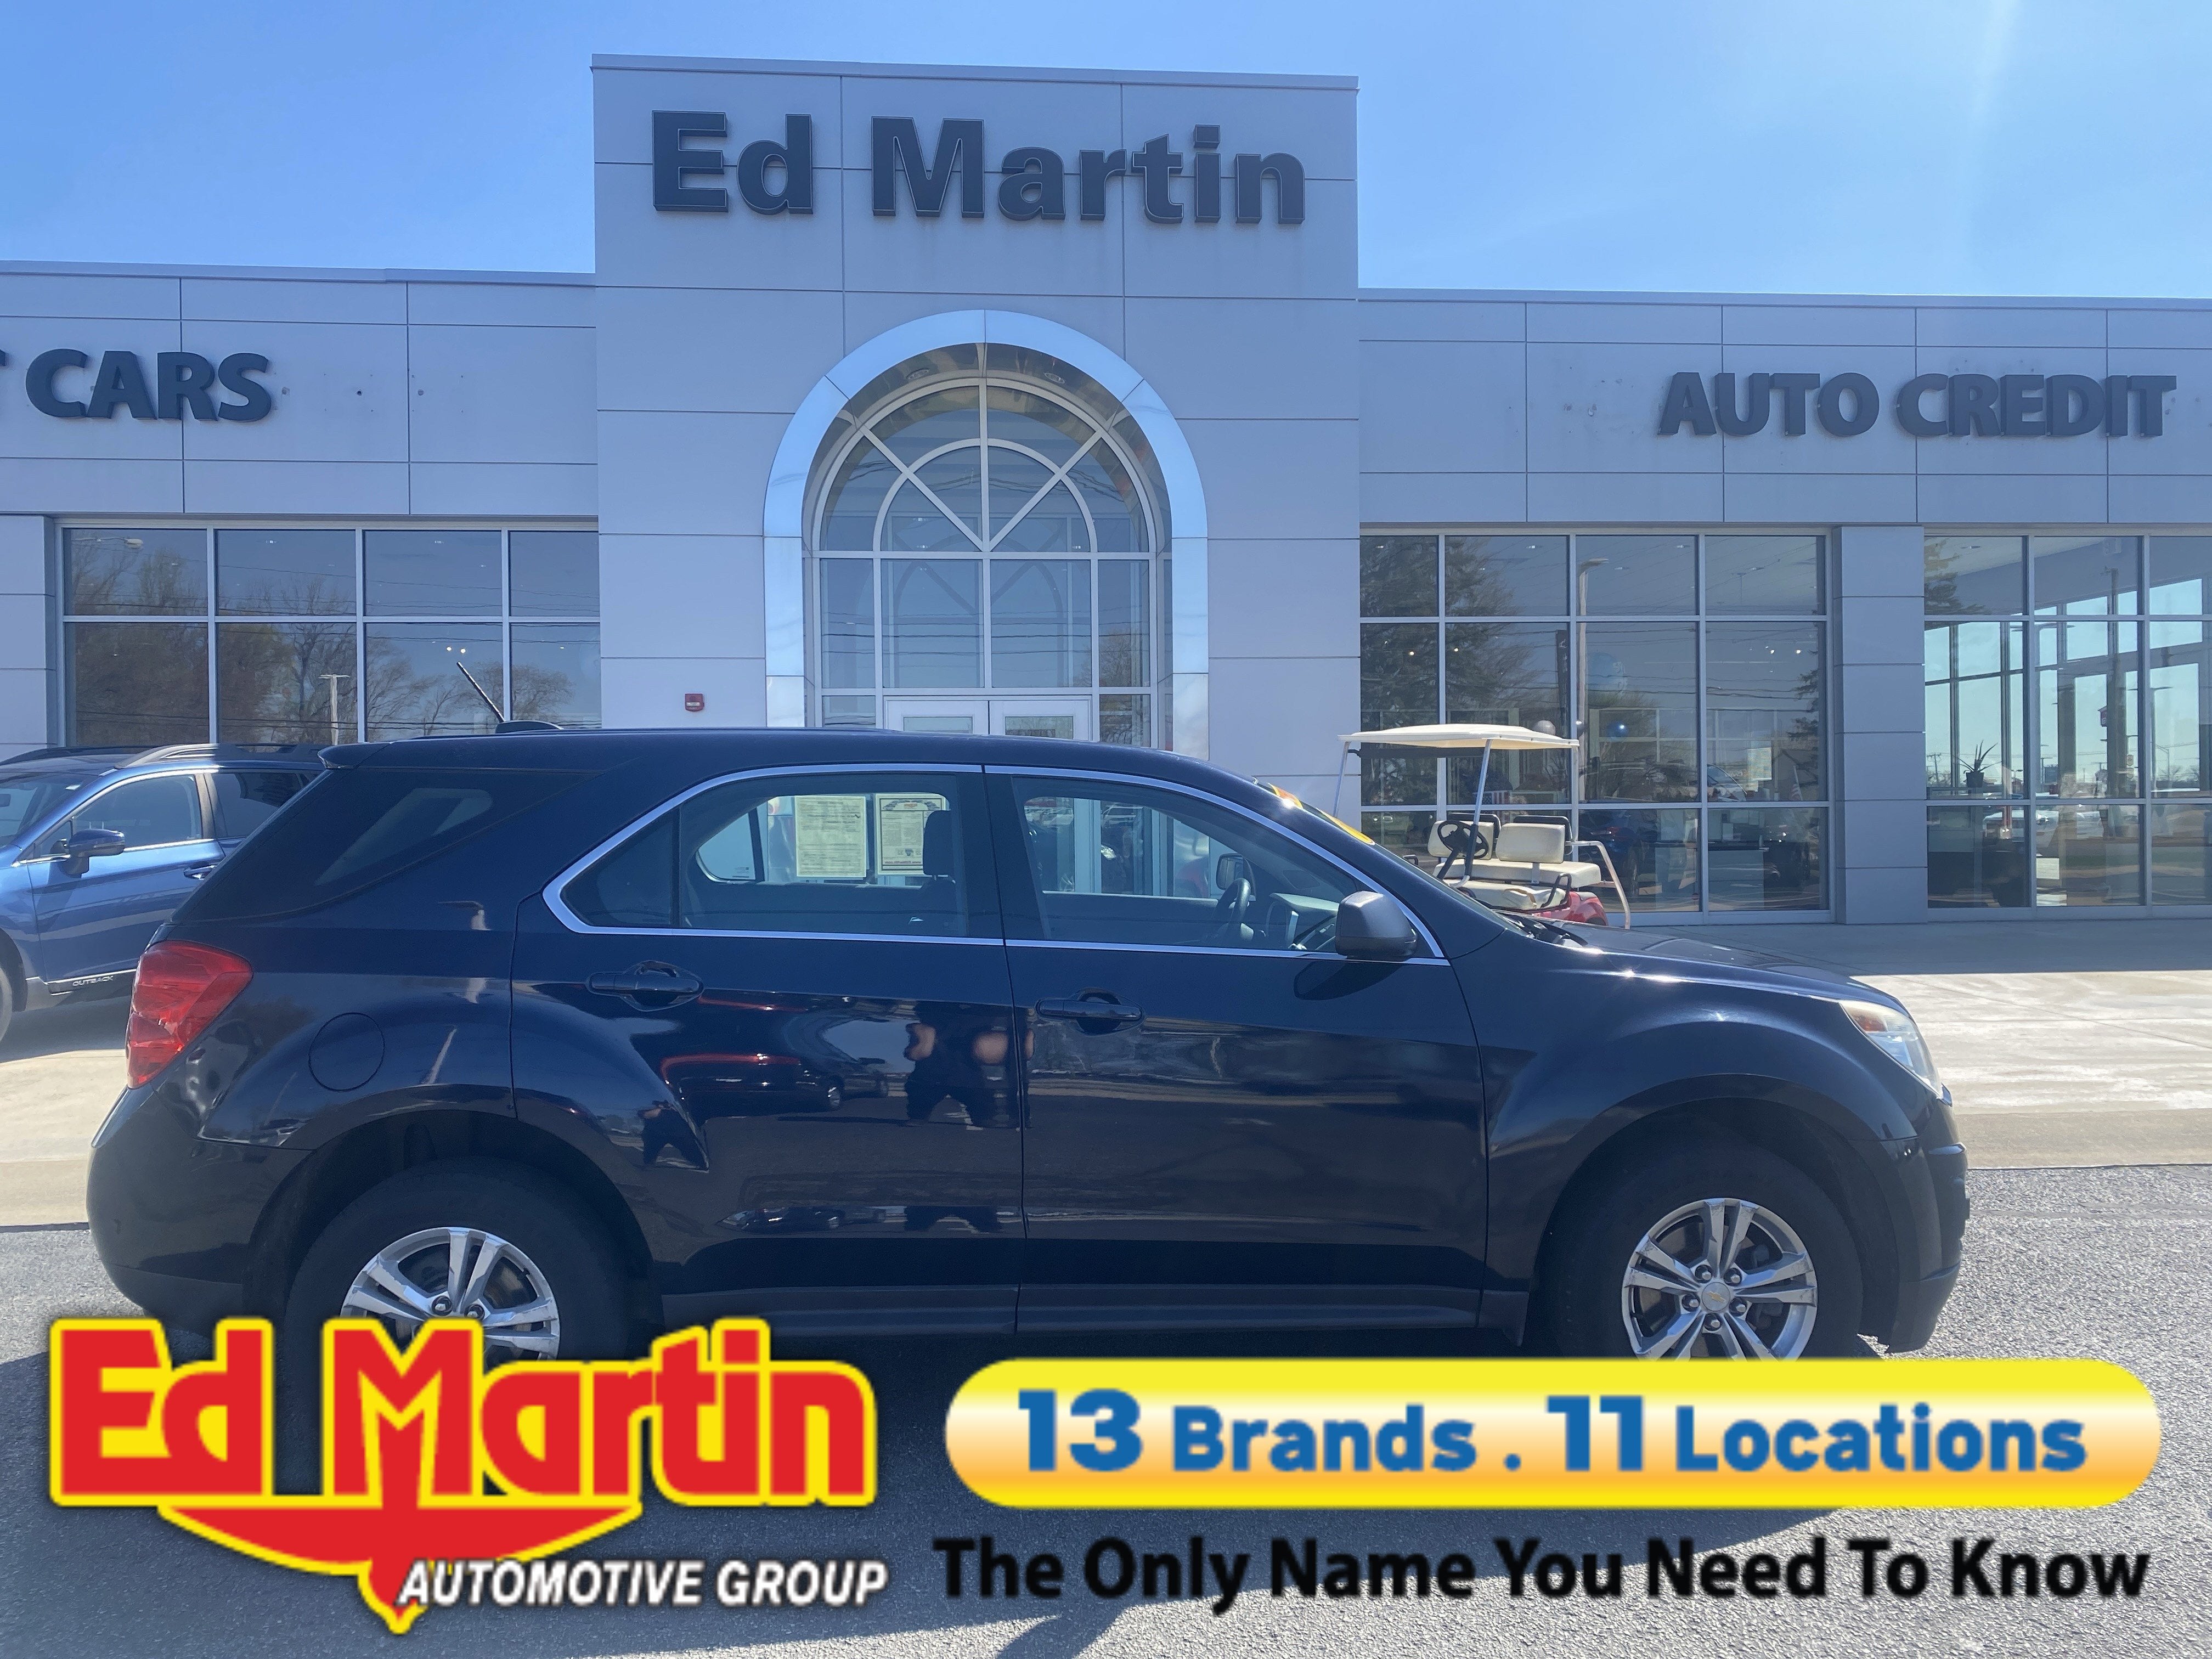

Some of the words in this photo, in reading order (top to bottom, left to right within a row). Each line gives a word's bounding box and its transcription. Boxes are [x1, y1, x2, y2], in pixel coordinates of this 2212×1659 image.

[652, 110, 812, 215] Ed
[871, 116, 1305, 224] Martin
[26, 348, 271, 422] CARS
[1657, 372, 1880, 436] AUTO
[1896, 374, 2177, 437] CREDIT
[72, 976, 114, 986] OUTBACK
